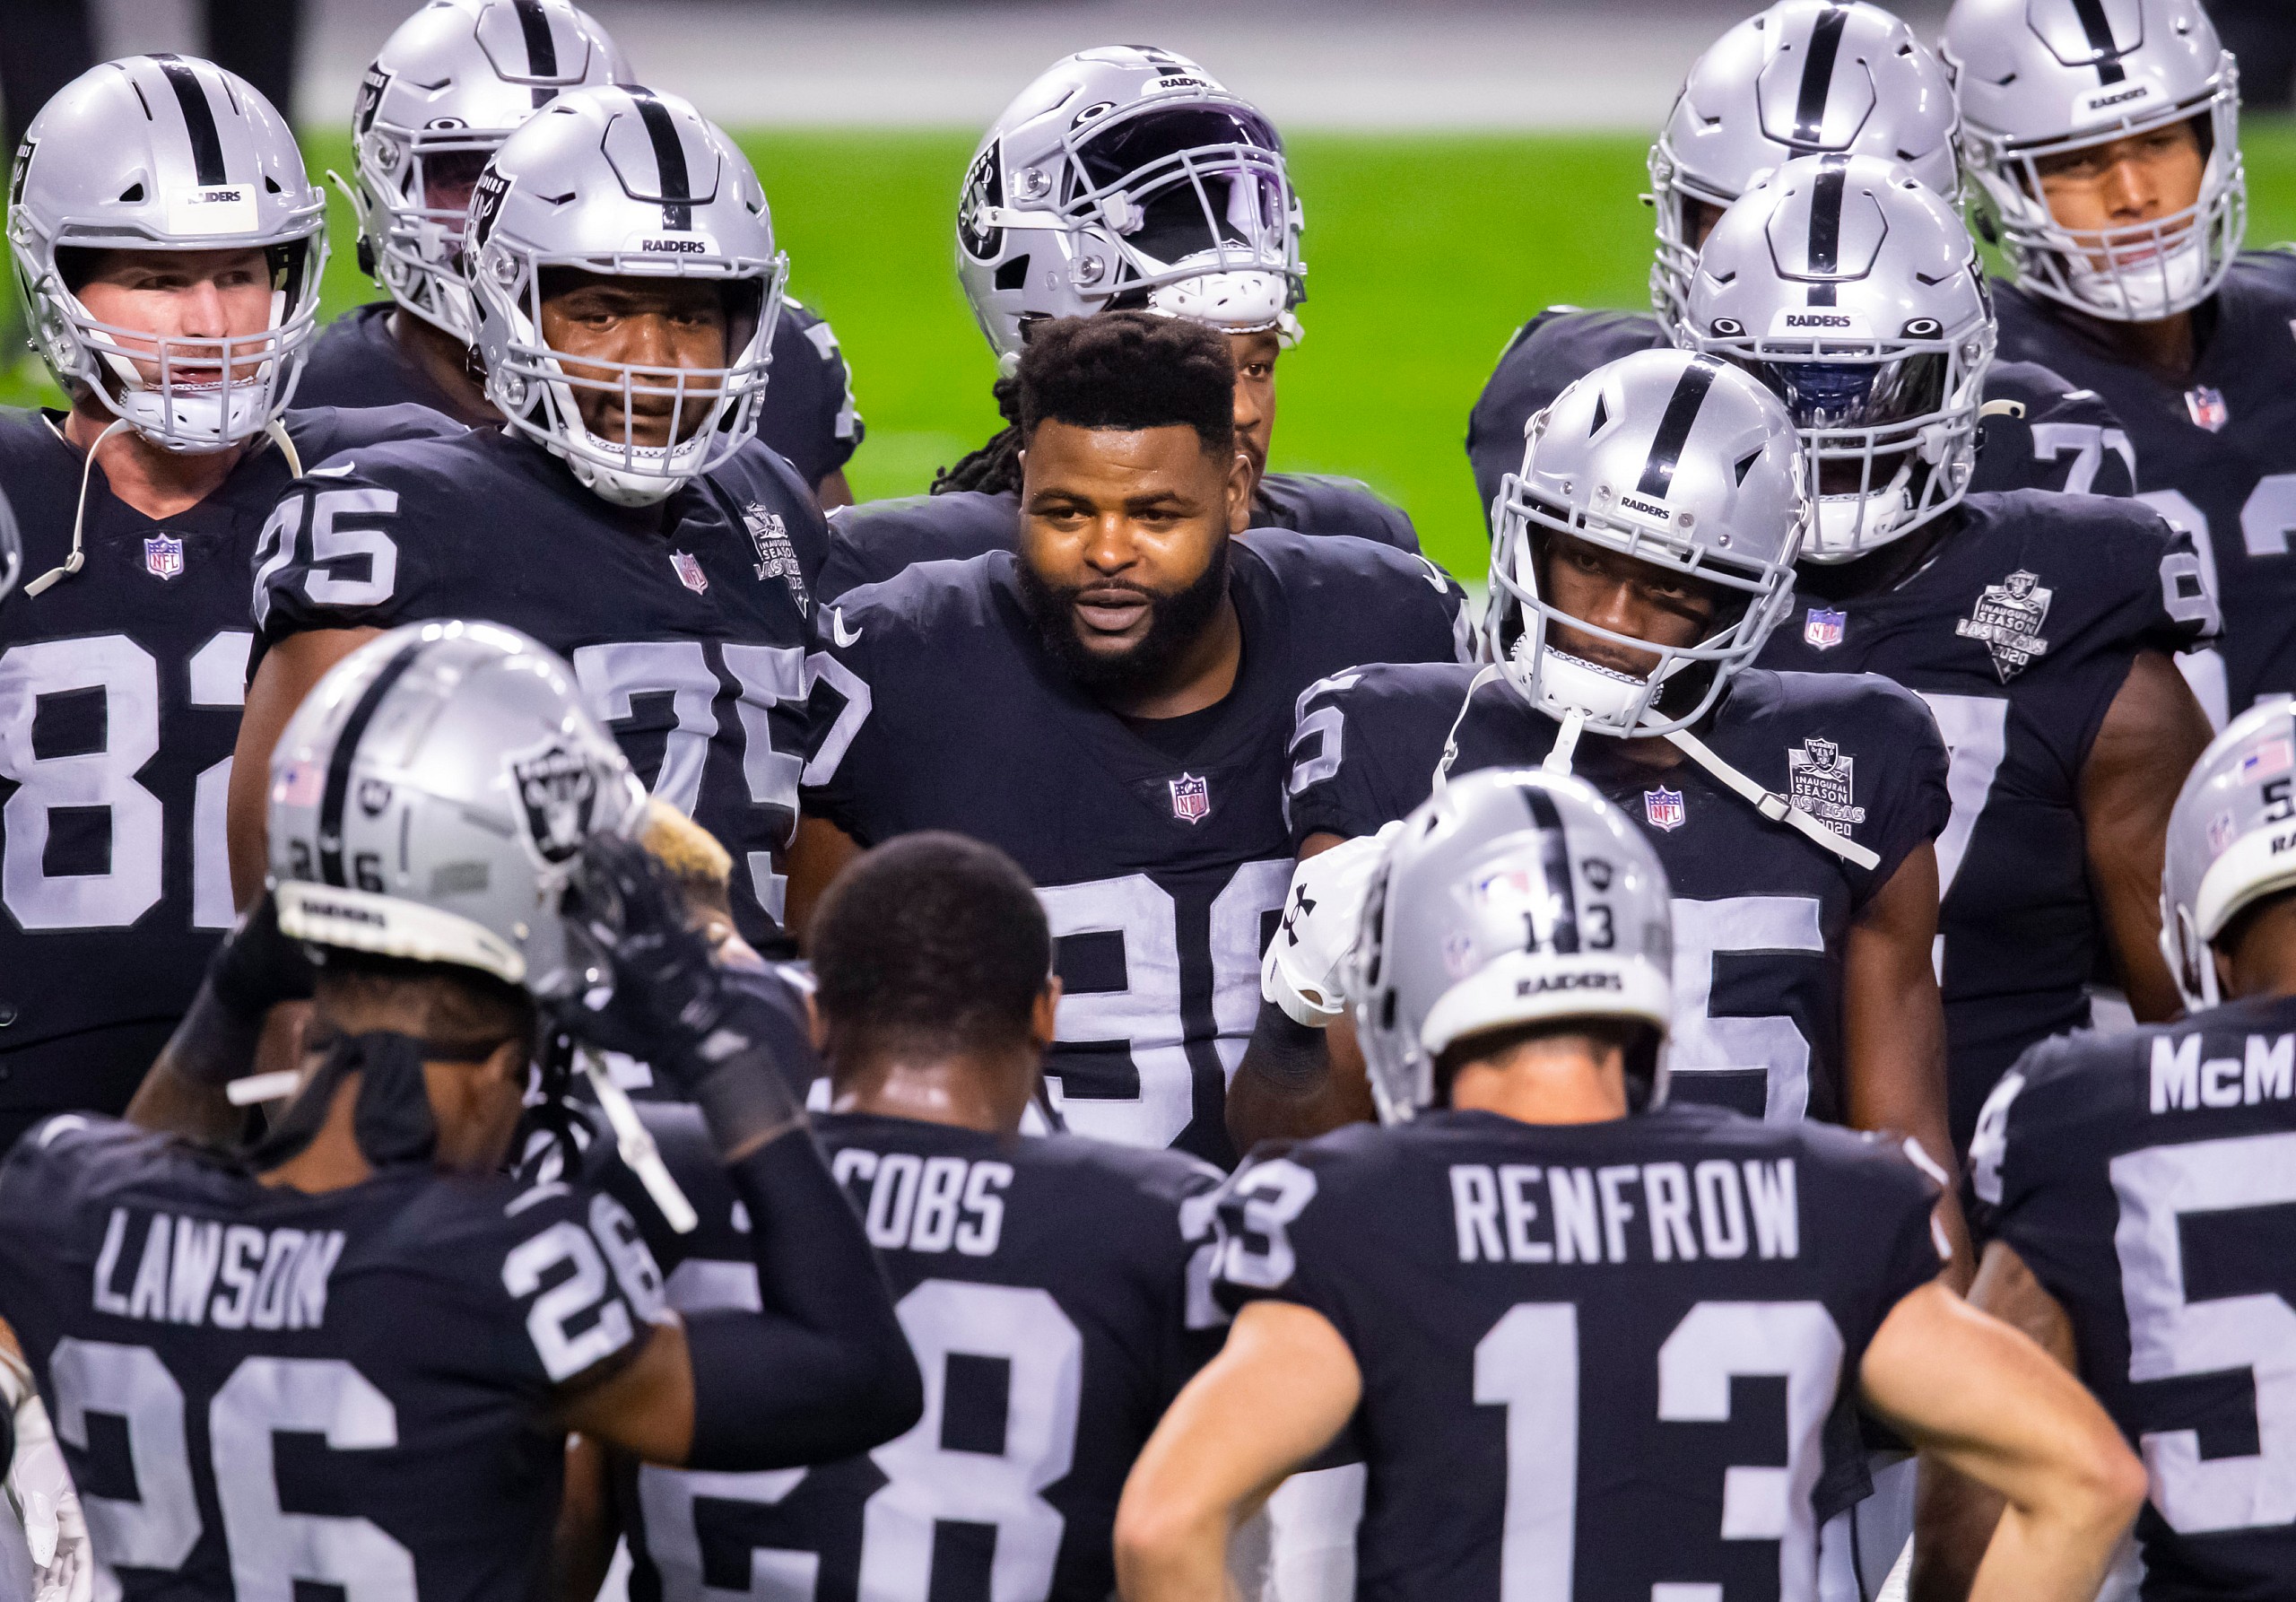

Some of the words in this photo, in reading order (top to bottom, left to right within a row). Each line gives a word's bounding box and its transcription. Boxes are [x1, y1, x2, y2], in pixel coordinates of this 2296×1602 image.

[642, 239, 706, 254] RAIDERS
[1786, 314, 1851, 327] RAIDERS
[1621, 496, 1670, 519] RAIDERS
[152, 553, 178, 570] NFL
[1977, 611, 2036, 634] SEASON
[1979, 603, 2039, 625] INAUGURAL
[1955, 618, 1992, 640] LAS
[1795, 775, 1848, 794] INAUGURAL
[1795, 783, 1848, 805] SEASON
[1178, 794, 1205, 814] NFL
[1653, 805, 1680, 822] NFL
[1813, 797, 1866, 824] VEGAS
[1449, 1158, 1800, 1264] RENFROW
[93, 1207, 347, 1330] LAWSON
[500, 1188, 679, 1384] 26
[1472, 1300, 1847, 1602] 13
[48, 1336, 419, 1602] 26
